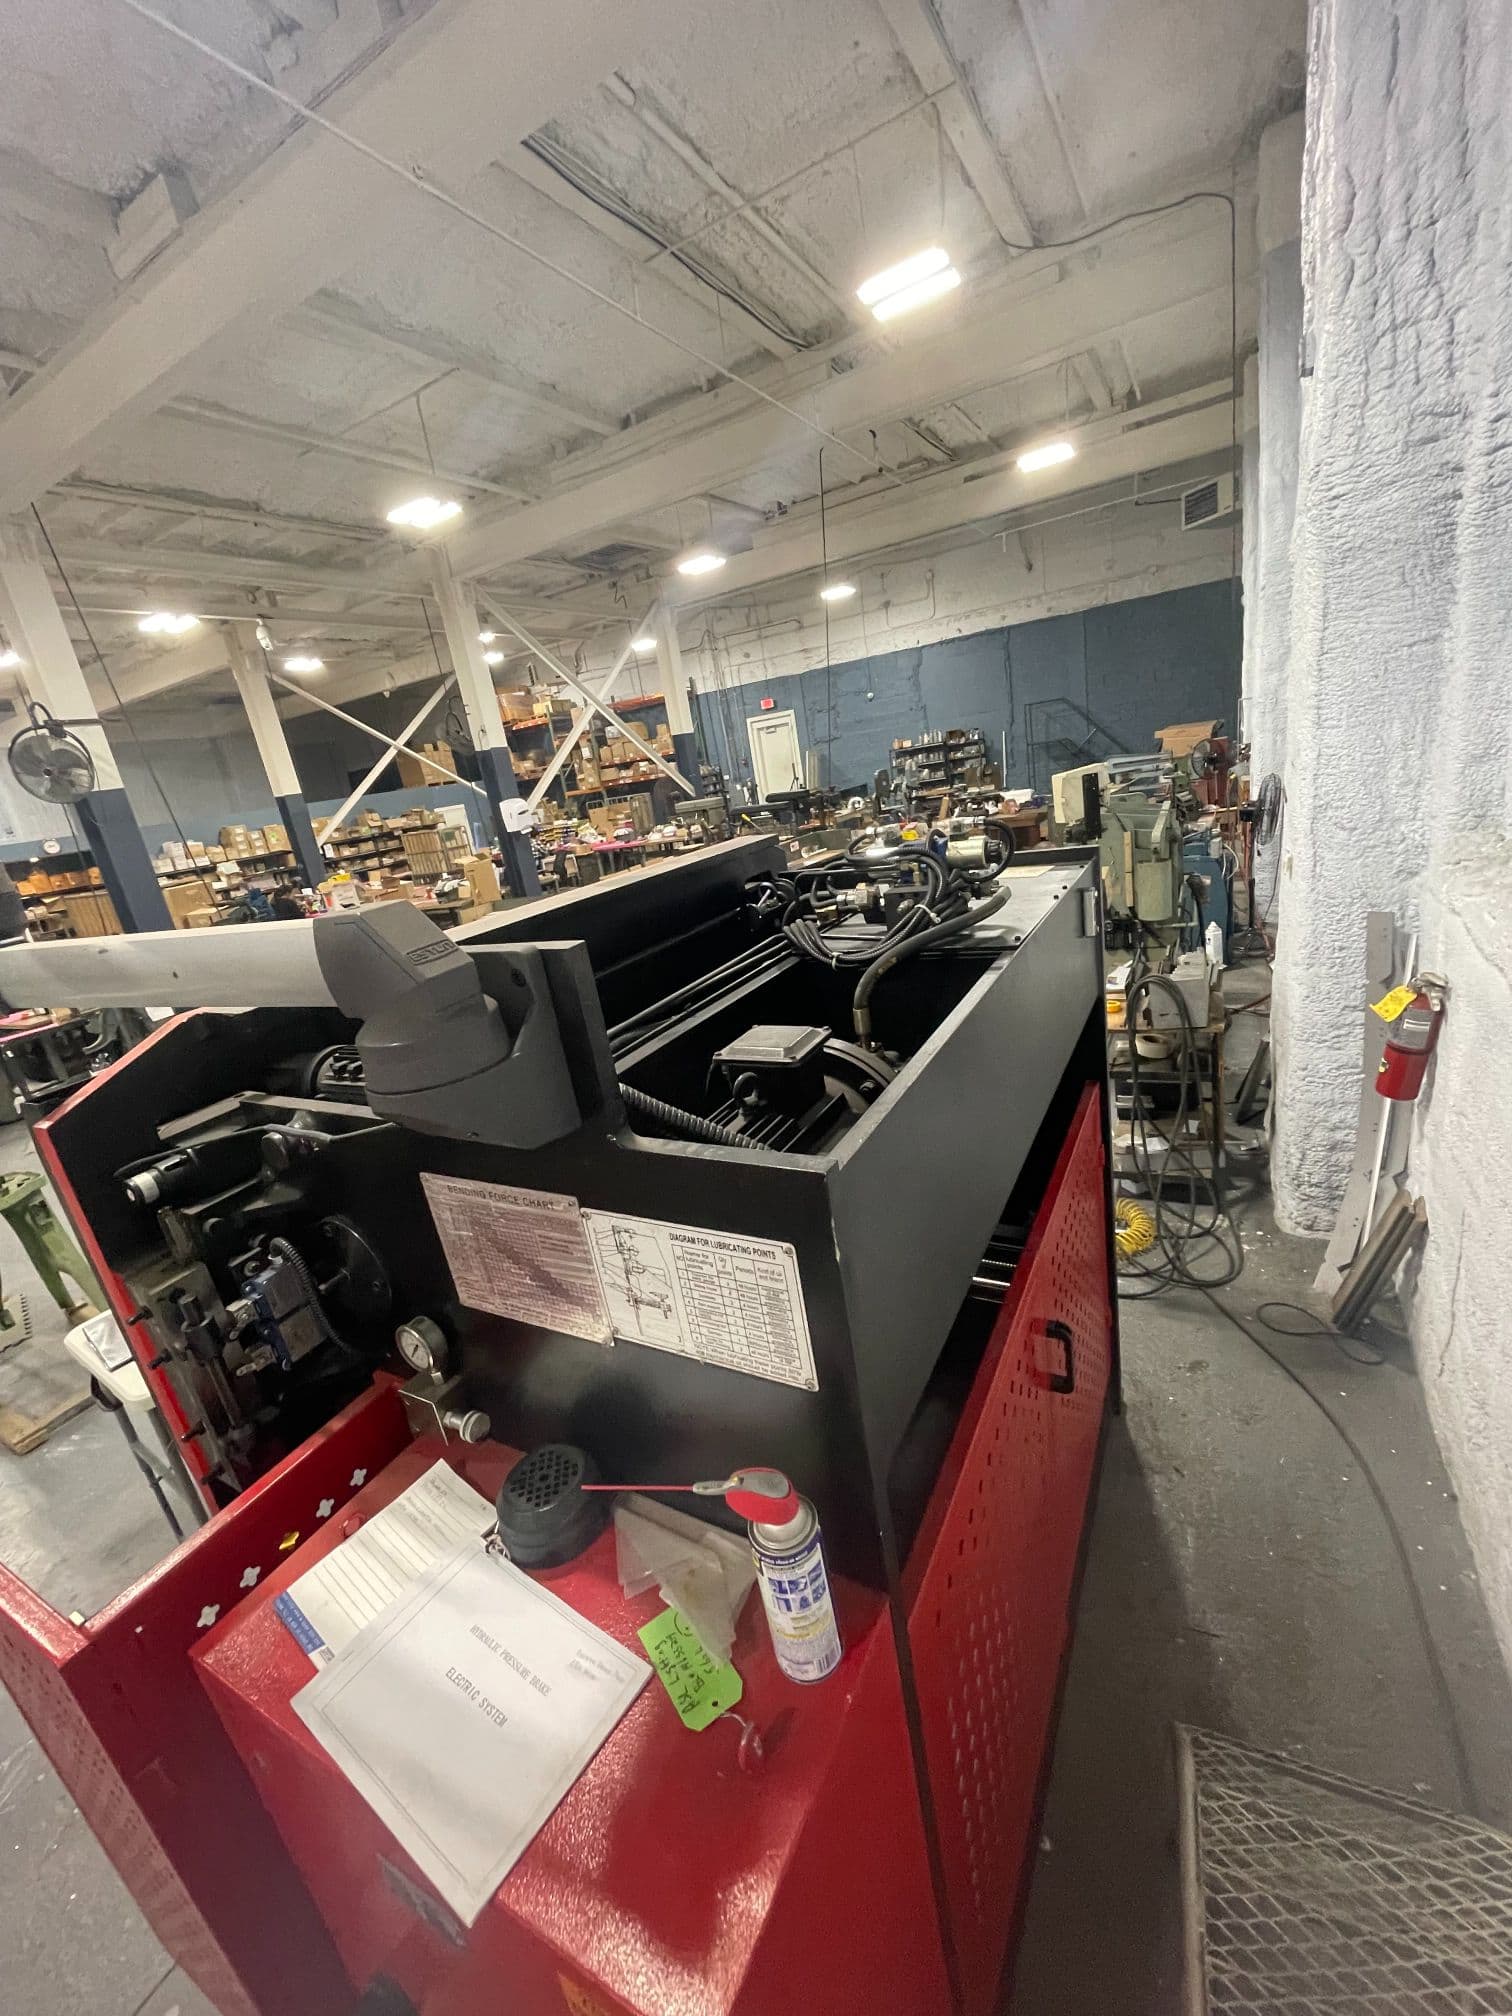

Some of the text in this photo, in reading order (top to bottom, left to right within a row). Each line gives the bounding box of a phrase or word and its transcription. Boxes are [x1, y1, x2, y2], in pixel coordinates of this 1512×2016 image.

[447, 1184, 555, 1210] BENDING FORCE CHART
[669, 1232, 777, 1260] DIAGRAM FOR LUBRICATING POINTS
[499, 1649, 532, 1682] PRESSURE
[529, 1674, 553, 1697] BRAKE
[445, 1666, 509, 1729] ELECTRIC SYSTEM
